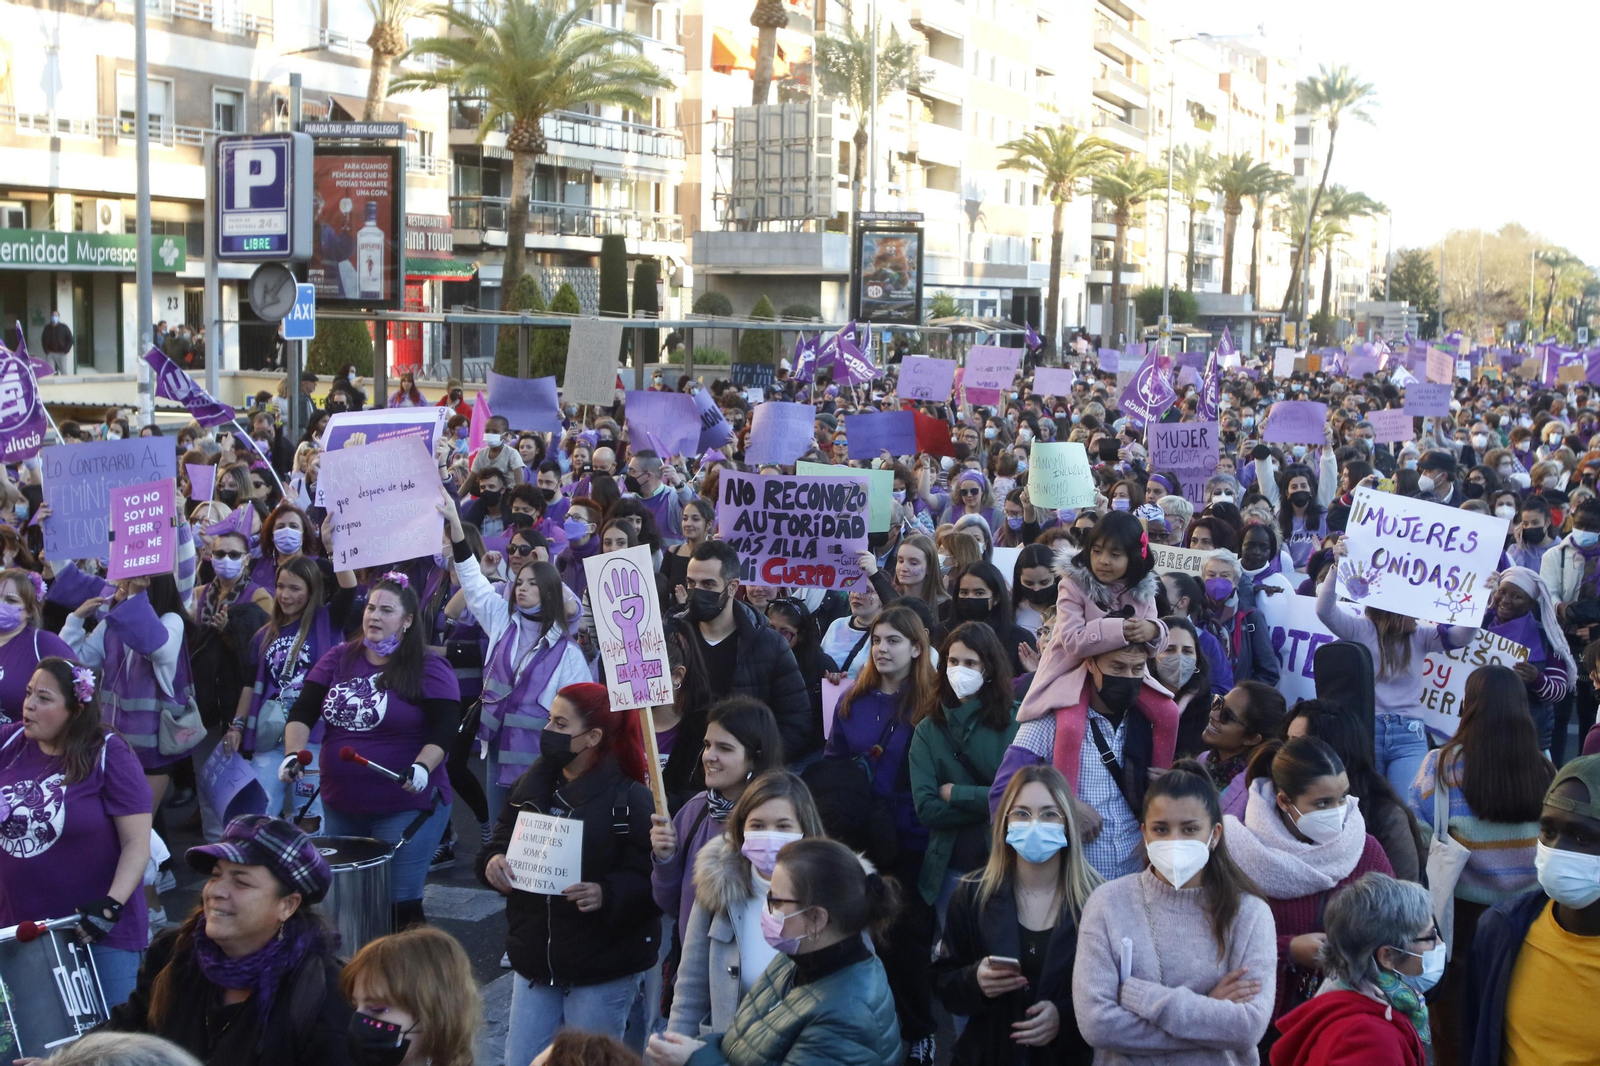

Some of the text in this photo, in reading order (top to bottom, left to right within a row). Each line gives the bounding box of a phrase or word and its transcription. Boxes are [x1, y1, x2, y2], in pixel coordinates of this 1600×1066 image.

[304, 123, 329, 134] PARADA
[328, 124, 342, 133] TAXI
[345, 124, 367, 134] PUERTA
[368, 125, 399, 135] GALLEGOS
[234, 148, 276, 209] P
[360, 180, 388, 188] TOMARTE
[258, 219, 273, 229] 24
[407, 215, 443, 228] RESTAURANTE
[0, 233, 69, 264] ernidad
[243, 238, 271, 250] LIBRE
[404, 231, 453, 252] HINA TOWN
[867, 285, 883, 298] RED
[167, 297, 179, 310] 23
[1156, 427, 1210, 450] MUJER,
[46, 445, 167, 479] LO CONTRARIO AL
[1152, 449, 1201, 464] ME GUSTA
[328, 443, 421, 492] AGRADECER
[358, 479, 416, 501] después de todo
[725, 478, 755, 507] NO
[123, 491, 160, 507] YO NO
[336, 497, 350, 514] que
[123, 505, 164, 522] SOY UN
[367, 500, 422, 527] LIBERTAD
[147, 536, 162, 548] ME
[727, 532, 767, 556] MÁS
[767, 537, 820, 560] ALLÁ
[123, 554, 160, 568] SILBES!
[340, 550, 347, 564] y
[349, 546, 359, 558] no
[760, 557, 836, 588] CUERPO
[1497, 636, 1529, 662] UNA
[525, 818, 533, 828] LA
[534, 819, 558, 832] TIERRA
[560, 824, 570, 834] NI
[517, 831, 563, 848] LAS MUJERES
[522, 847, 548, 860] SOMOS
[507, 858, 569, 877] TERRITORIOS DE
[513, 874, 556, 890] ONQUISTA
